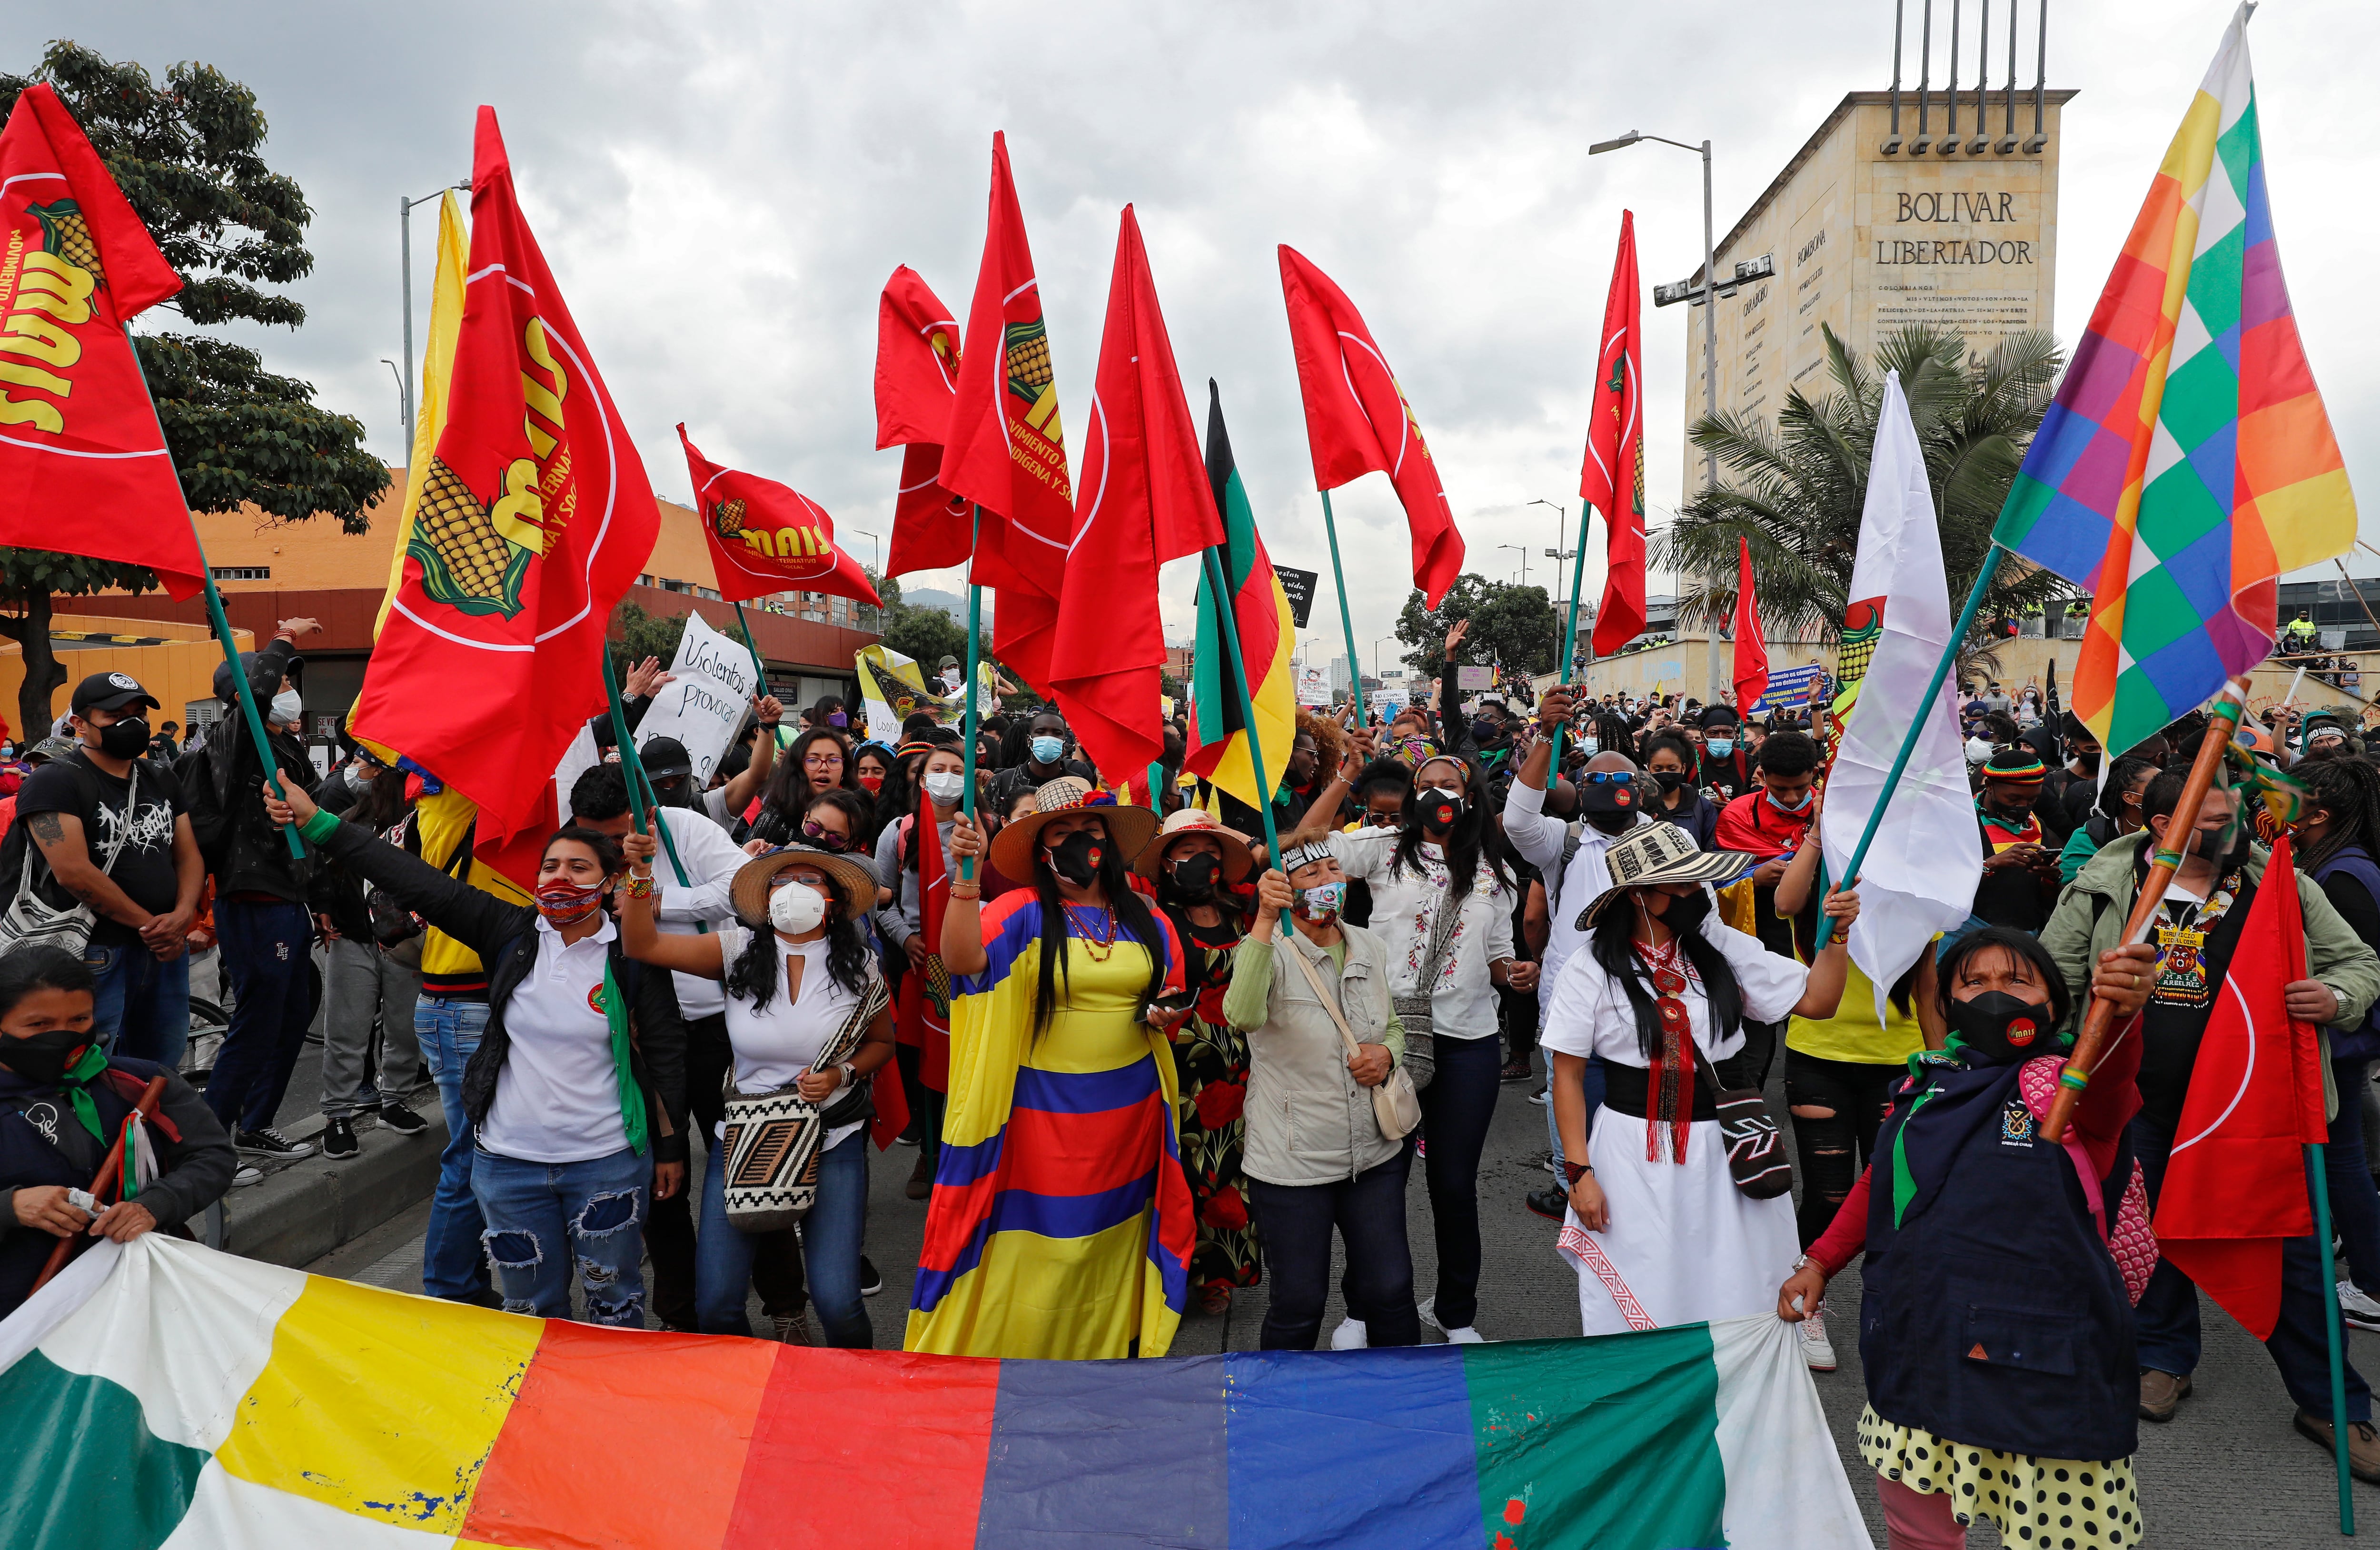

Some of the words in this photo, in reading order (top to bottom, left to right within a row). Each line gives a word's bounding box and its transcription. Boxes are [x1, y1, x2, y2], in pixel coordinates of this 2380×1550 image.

[1896, 192, 2016, 223] BOLIVAR
[1797, 228, 1825, 268] BOMBONA
[1877, 240, 2033, 265] LIBERTADOR
[1743, 284, 1768, 317] CARABOBO
[1011, 442, 1051, 485] NDÍGENA
[1288, 582, 1306, 590] vida.
[685, 635, 745, 695] Violentos
[1769, 672, 1789, 681] silencio
[318, 718, 325, 726] SE
[1282, 847, 1303, 864] PARO
[1287, 856, 1308, 872] NACIONAL
[2015, 1028, 2034, 1038] MAIS
